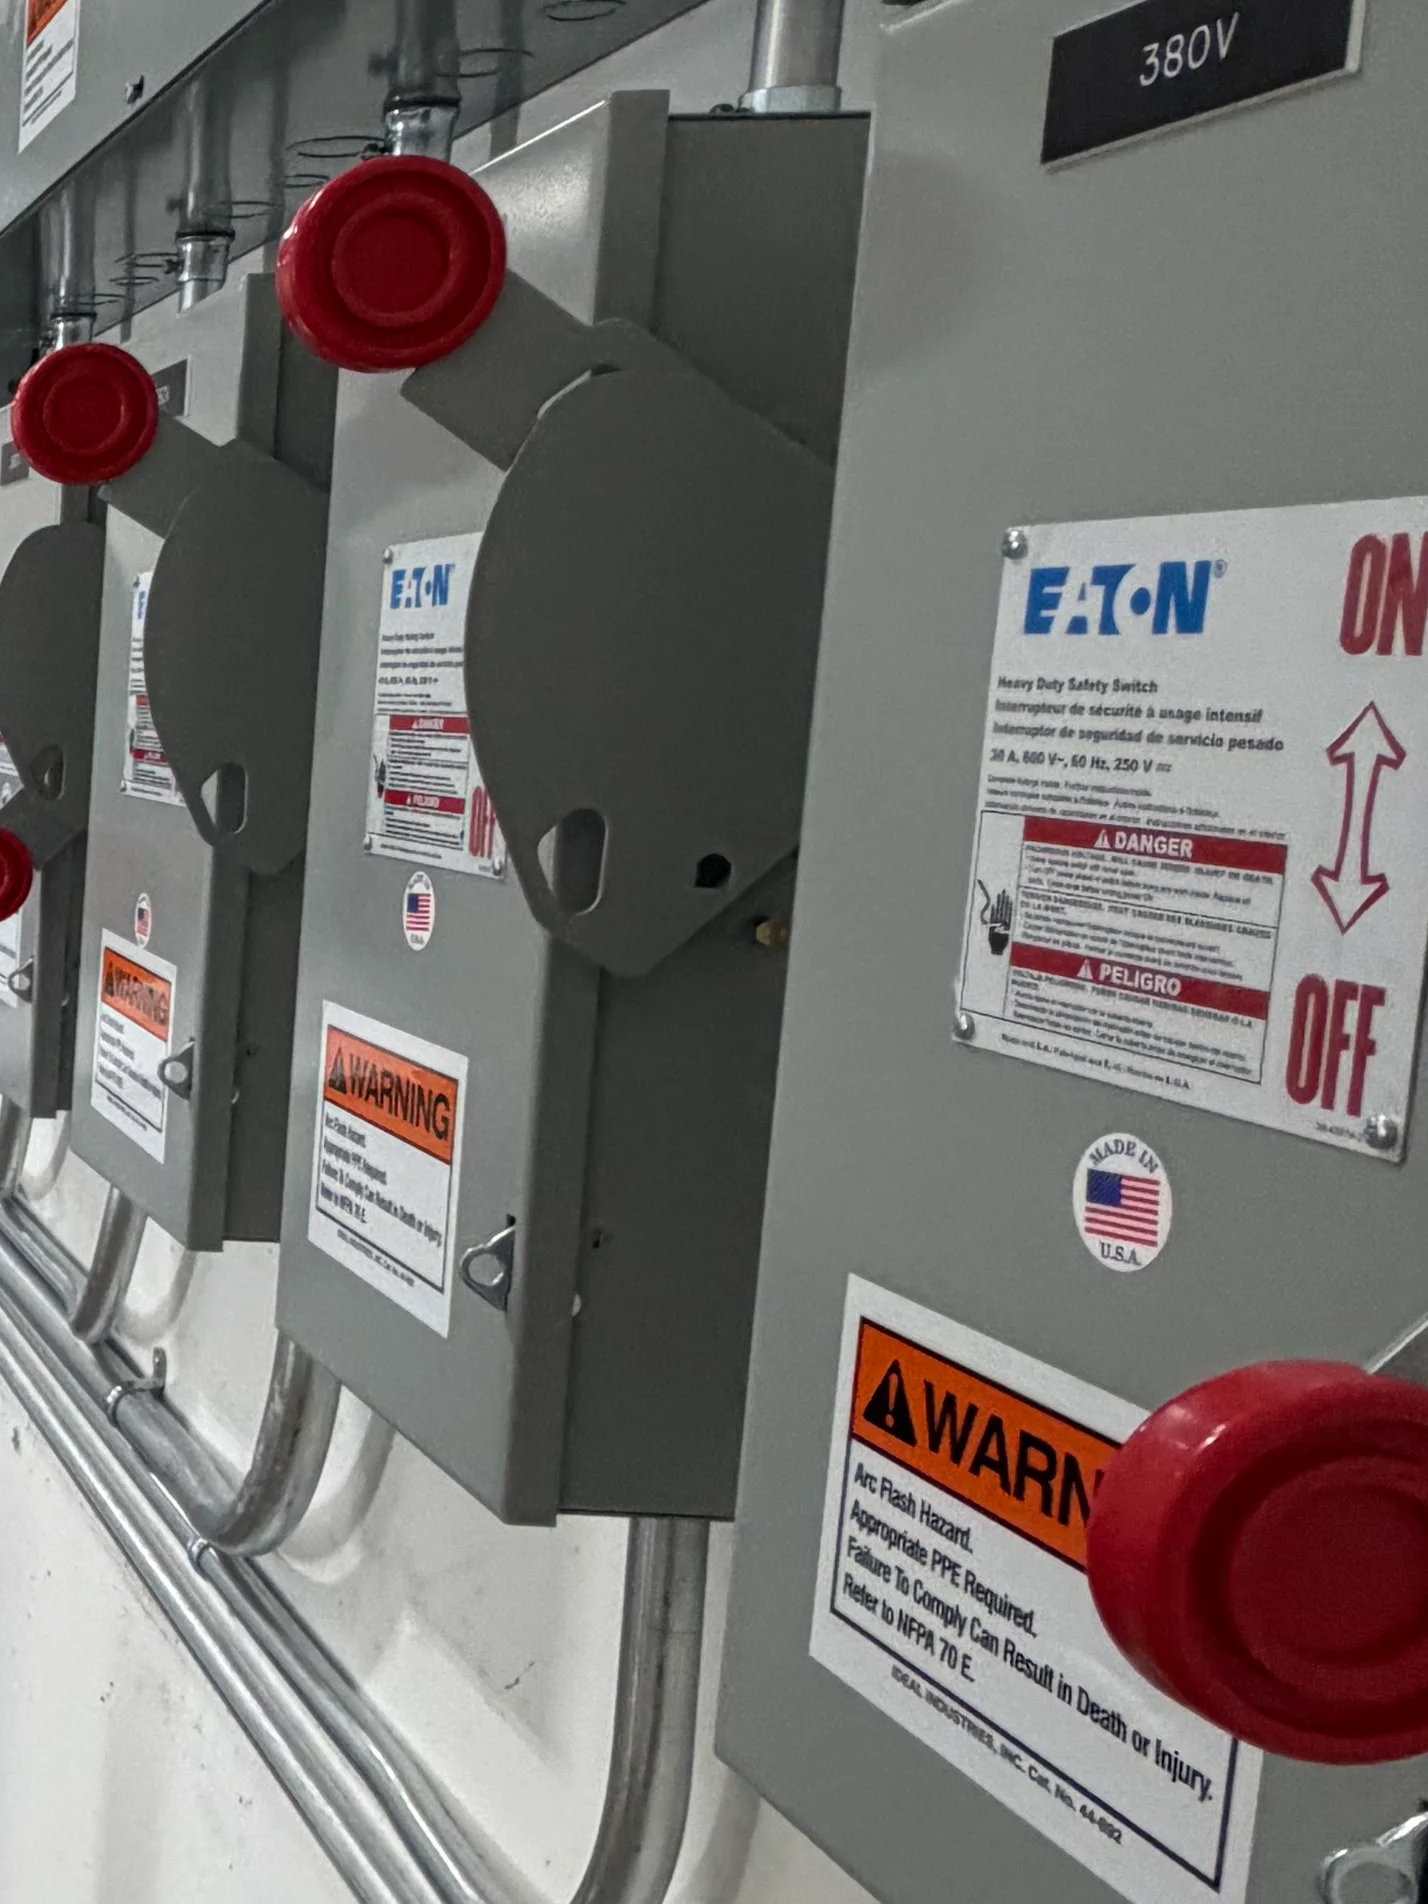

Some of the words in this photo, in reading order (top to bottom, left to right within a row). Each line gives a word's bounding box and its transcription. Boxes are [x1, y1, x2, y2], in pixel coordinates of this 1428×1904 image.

[1138, 12, 1239, 87] 380V
[389, 563, 451, 609] EATON
[1023, 559, 1213, 636] EATON
[1338, 532, 1428, 656] ON
[997, 676, 1033, 693] Heavy
[1036, 677, 1065, 694] Duty
[1068, 677, 1109, 695] Safety
[1112, 678, 1158, 693] Switch
[1069, 703, 1085, 716] de
[1159, 708, 1201, 724] usage
[1205, 706, 1264, 723] intensif
[1059, 726, 1075, 738] de
[1078, 728, 1143, 743] seguridad
[1146, 730, 1164, 744] de
[1168, 733, 1224, 747] servicio
[1228, 736, 1285, 752] pesado
[1113, 757, 1139, 772] 250
[1114, 831, 1193, 858] DANGER
[1098, 963, 1181, 997] PELIGRO
[1285, 974, 1385, 1118] OFF
[349, 1052, 451, 1141] WARNING
[1089, 1139, 1136, 1166] MADE
[1139, 1150, 1159, 1174] IN
[923, 1379, 1105, 1528] WARN
[854, 1462, 877, 1494] Arc
[880, 1477, 916, 1518] Flash
[919, 1498, 973, 1554] Hazard.
[850, 1498, 927, 1566] Appropriate
[931, 1548, 962, 1588] PPE
[964, 1570, 1037, 1639] Required.
[843, 1572, 879, 1615] Refer
[882, 1599, 894, 1626] to
[897, 1608, 936, 1657] NFPA
[939, 1637, 958, 1670] 70
[847, 1536, 892, 1583] Failure
[894, 1564, 910, 1596] To
[913, 1579, 968, 1638] Comply
[969, 1617, 998, 1657] Can
[1003, 1637, 1054, 1693] Result
[1057, 1673, 1073, 1706] in
[1077, 1685, 1128, 1744] Death
[1131, 1729, 1151, 1758] or
[1155, 1738, 1213, 1802] Injury.
[892, 1664, 923, 1699] IDEAL
